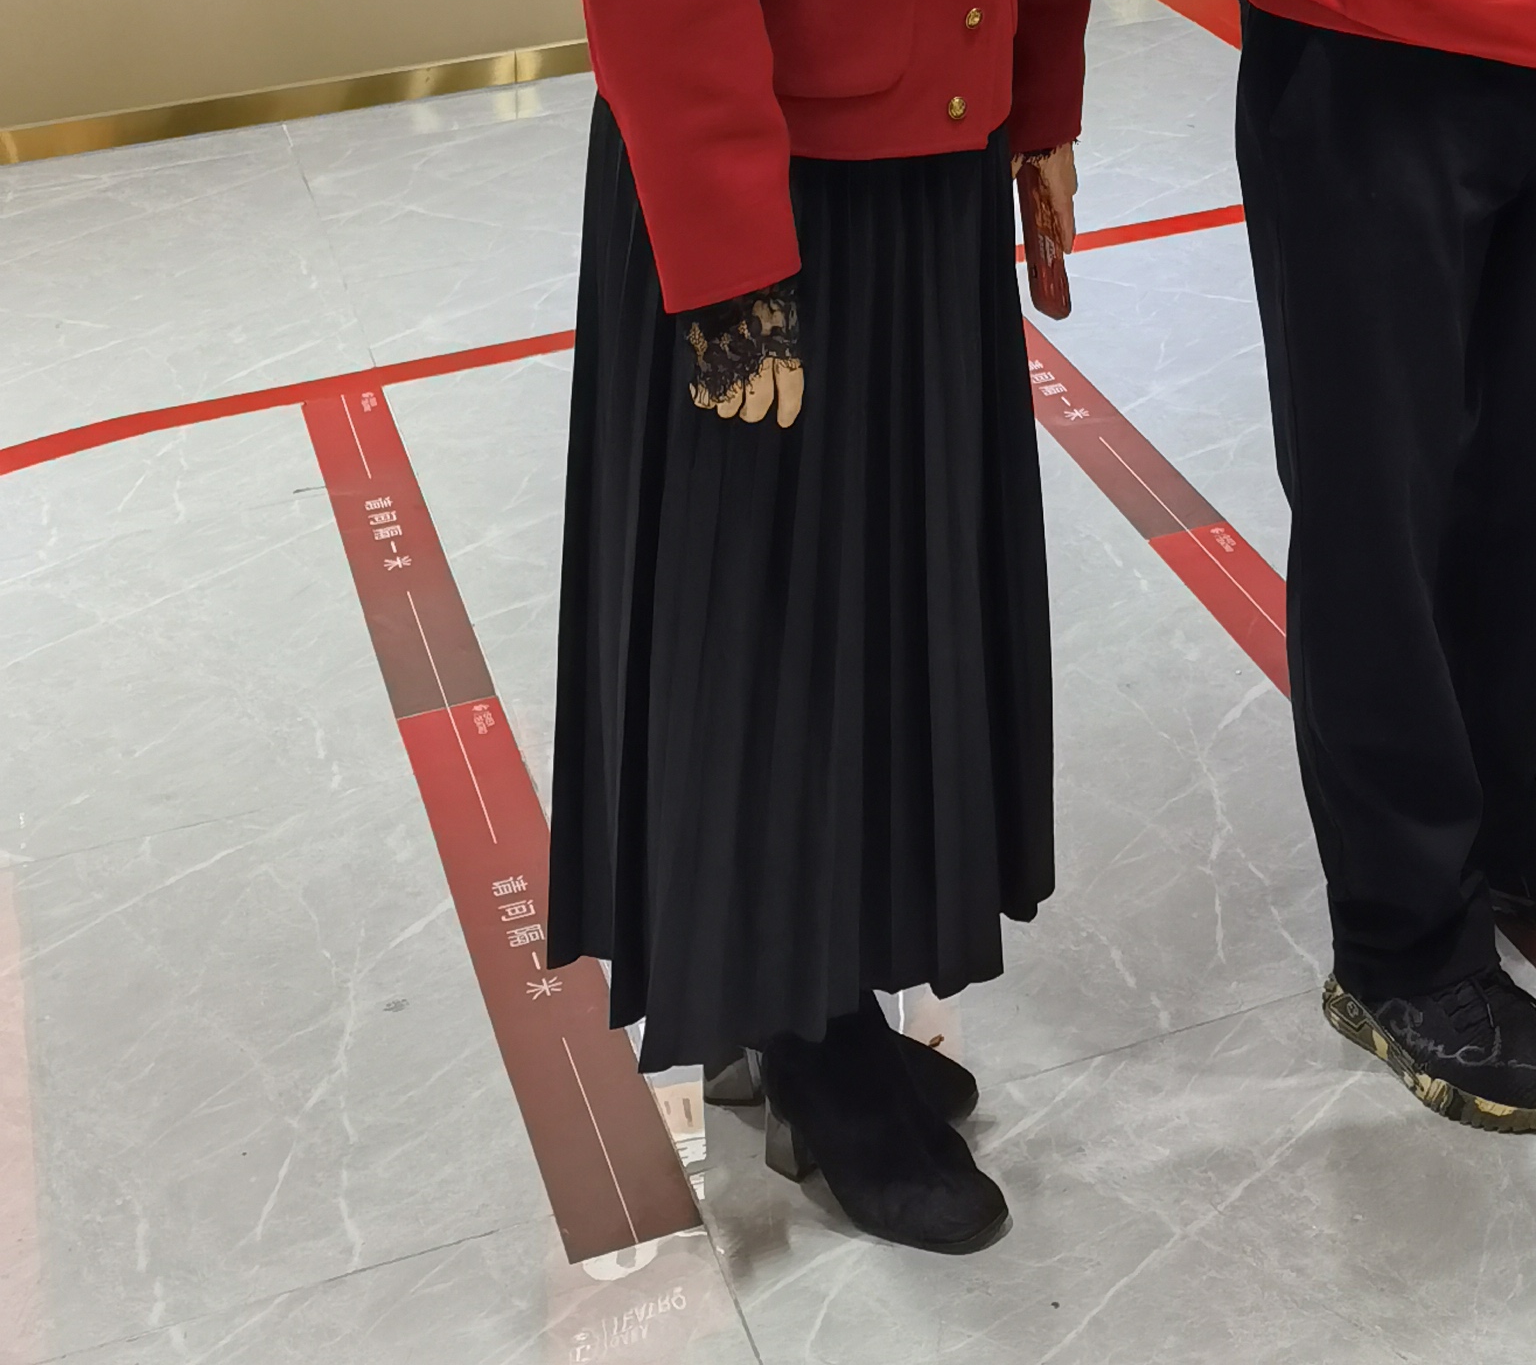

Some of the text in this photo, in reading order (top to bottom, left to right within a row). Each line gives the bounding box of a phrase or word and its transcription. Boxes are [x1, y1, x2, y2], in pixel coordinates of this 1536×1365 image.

[364, 495, 413, 572] 请间隔一米
[491, 874, 563, 1000] 请间隔一米
